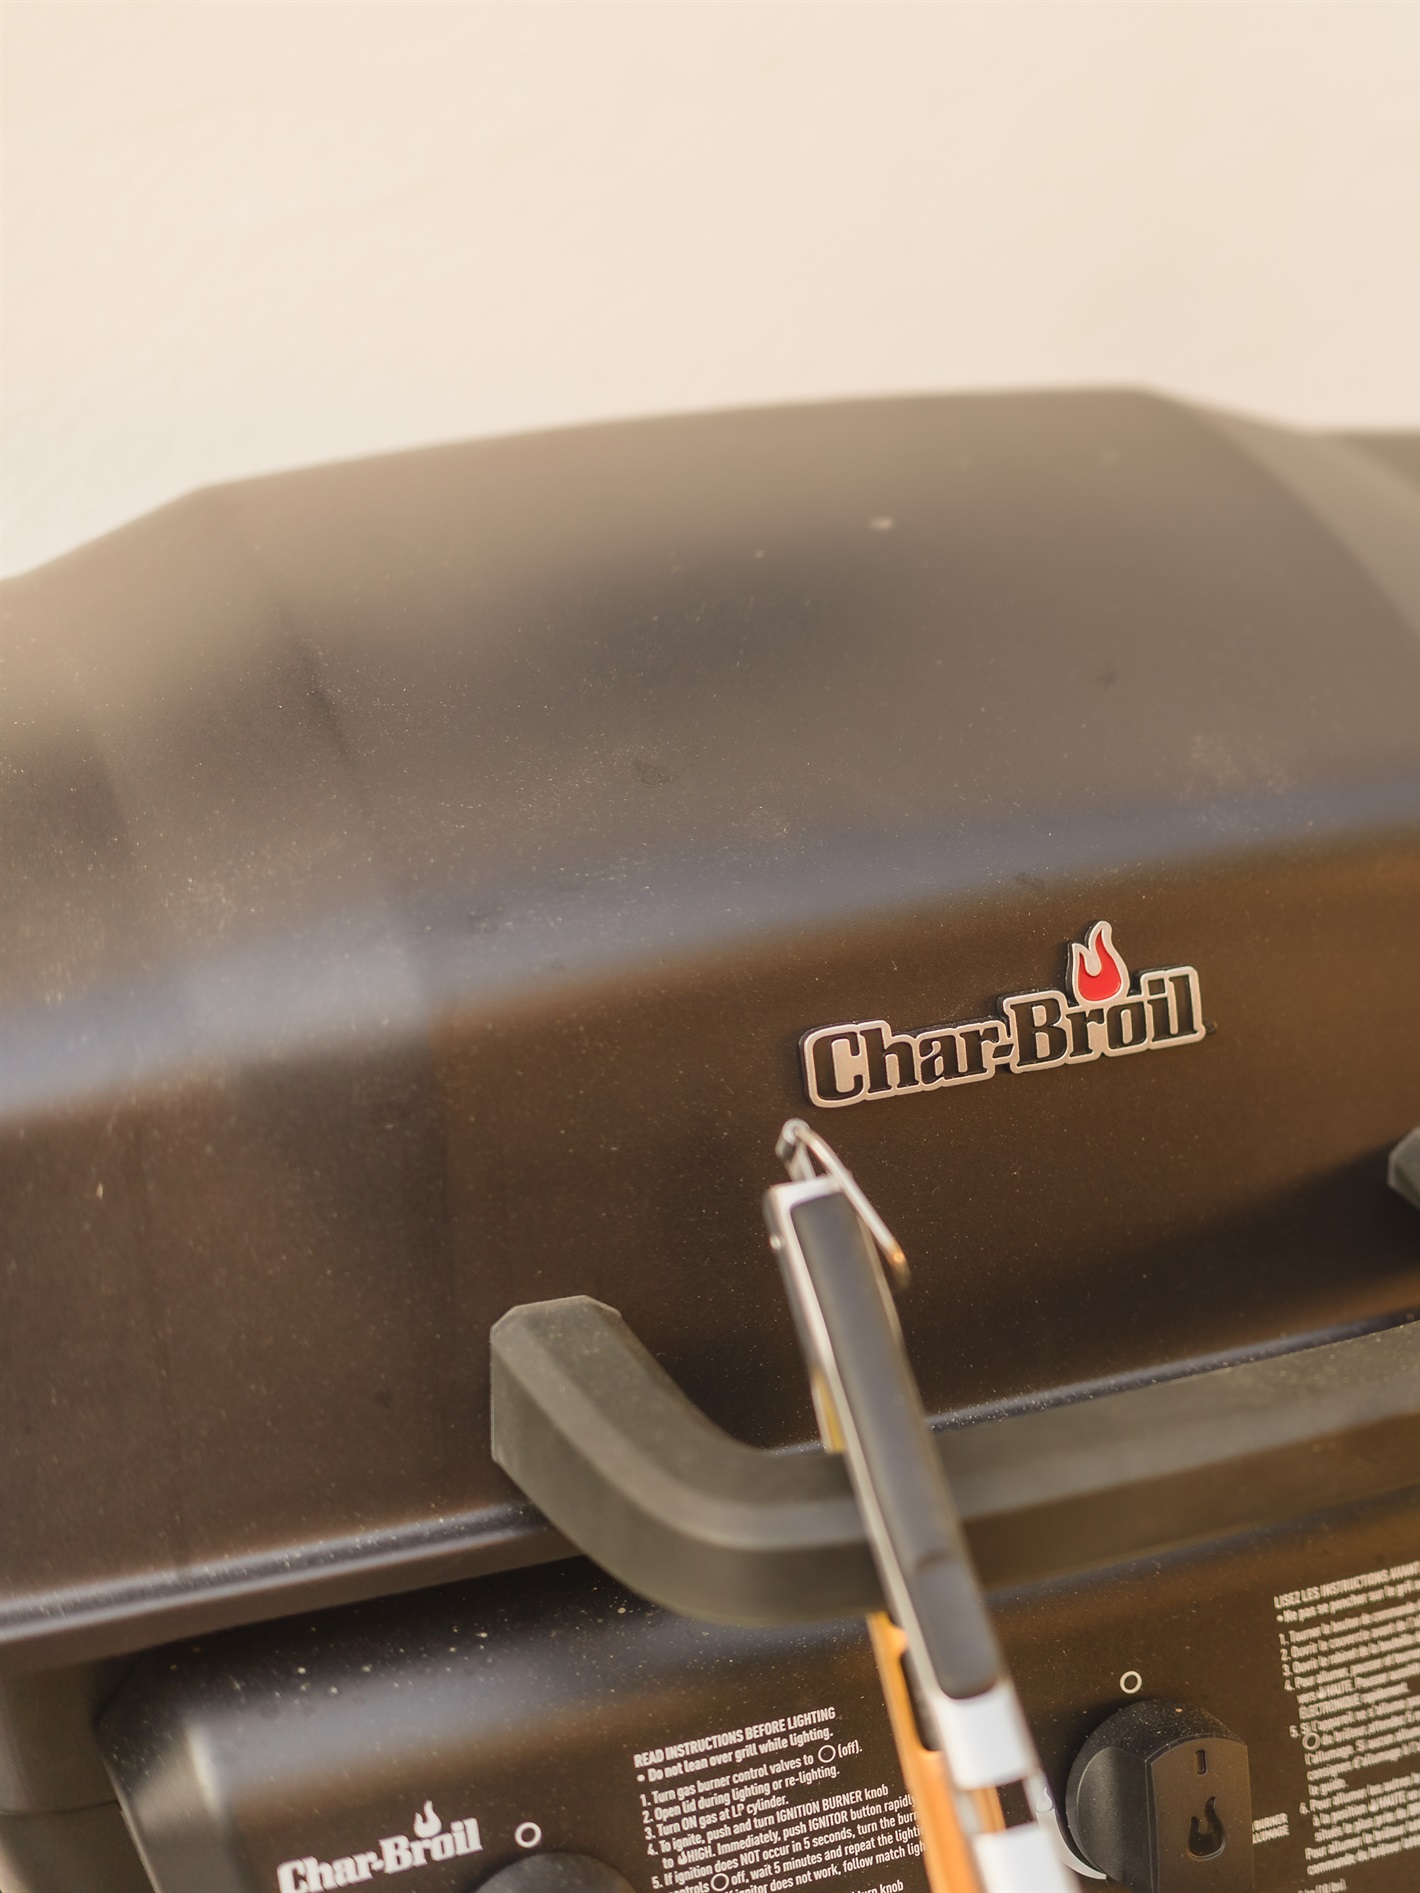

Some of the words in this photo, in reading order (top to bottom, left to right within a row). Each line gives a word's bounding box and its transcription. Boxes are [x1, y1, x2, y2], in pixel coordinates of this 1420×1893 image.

[804, 967, 1204, 1107] Char-Broil
[633, 1748, 665, 1769] READ
[664, 1729, 745, 1761] INSTRUCTIONS
[744, 1718, 787, 1741] BEFORE
[786, 1706, 836, 1730] LIGHTING
[647, 1767, 664, 1782] Do
[663, 1762, 684, 1778] not
[683, 1757, 709, 1773] lean
[708, 1751, 734, 1767] over
[734, 1742, 759, 1763] grill
[757, 1736, 789, 1754] while
[788, 1727, 834, 1748] lighting.
[639, 1793, 652, 1807] 1.
[651, 1789, 677, 1804] Turn
[676, 1784, 697, 1801] gas
[696, 1775, 731, 1793] burner
[731, 1763, 770, 1784] control
[768, 1757, 802, 1775] valves
[802, 1754, 815, 1766] to
[837, 1739, 863, 1758] (off).
[641, 1810, 654, 1824] 2.
[653, 1805, 682, 1822] Open
[681, 1798, 697, 1814] lid
[697, 1792, 731, 1810] during
[731, 1782, 771, 1803] lighting
[771, 1779, 783, 1791] or
[784, 1765, 841, 1788] re-lighting.
[644, 1826, 657, 1841] 3.
[655, 1822, 681, 1837] Turn
[680, 1814, 698, 1831] ON
[698, 1812, 718, 1830] gas
[718, 1807, 731, 1822] at
[730, 1803, 745, 1818] LP
[746, 1794, 790, 1816] cylinder.
[647, 1843, 659, 1856] 4.
[658, 1839, 672, 1853] To
[671, 1833, 706, 1853] ignite,
[706, 1823, 732, 1845] push
[732, 1817, 753, 1835] and
[752, 1815, 776, 1829] turn
[775, 1800, 821, 1824] IGNITION
[821, 1790, 863, 1817] BURNER
[864, 1784, 889, 1801] knob
[661, 1857, 675, 1870] to
[686, 1844, 717, 1864] HIGH.
[716, 1829, 782, 1856] Immediately,
[782, 1821, 808, 1842] push
[807, 1810, 849, 1832] IGNITOR
[849, 1804, 883, 1821] button
[651, 1875, 664, 1890] 5.
[663, 1871, 673, 1886] If
[673, 1864, 715, 1886] ignition
[713, 1858, 740, 1879] does
[739, 1849, 761, 1867] NOT
[762, 1844, 791, 1866] occur
[791, 1840, 803, 1853] in
[802, 1836, 811, 1850] 5
[811, 1827, 856, 1848] seconds,
[856, 1821, 881, 1840] turn
[878, 1817, 898, 1837] the
[897, 1812, 919, 1825] burn
[668, 1881, 710, 1893] ontrols
[730, 1869, 750, 1886] off,
[749, 1863, 774, 1881] wait
[773, 1860, 781, 1874] 5
[782, 1852, 823, 1873] minutes
[823, 1844, 843, 1861] and
[843, 1836, 877, 1859] repeat
[876, 1833, 894, 1847] the
[895, 1825, 920, 1843] lighti
[769, 1877, 794, 1892] does
[795, 1870, 813, 1886] not
[812, 1863, 842, 1881] work,
[842, 1855, 874, 1873] follow
[875, 1845, 906, 1865] match
[907, 1841, 926, 1857] ligh
[879, 1879, 904, 1893] knob
